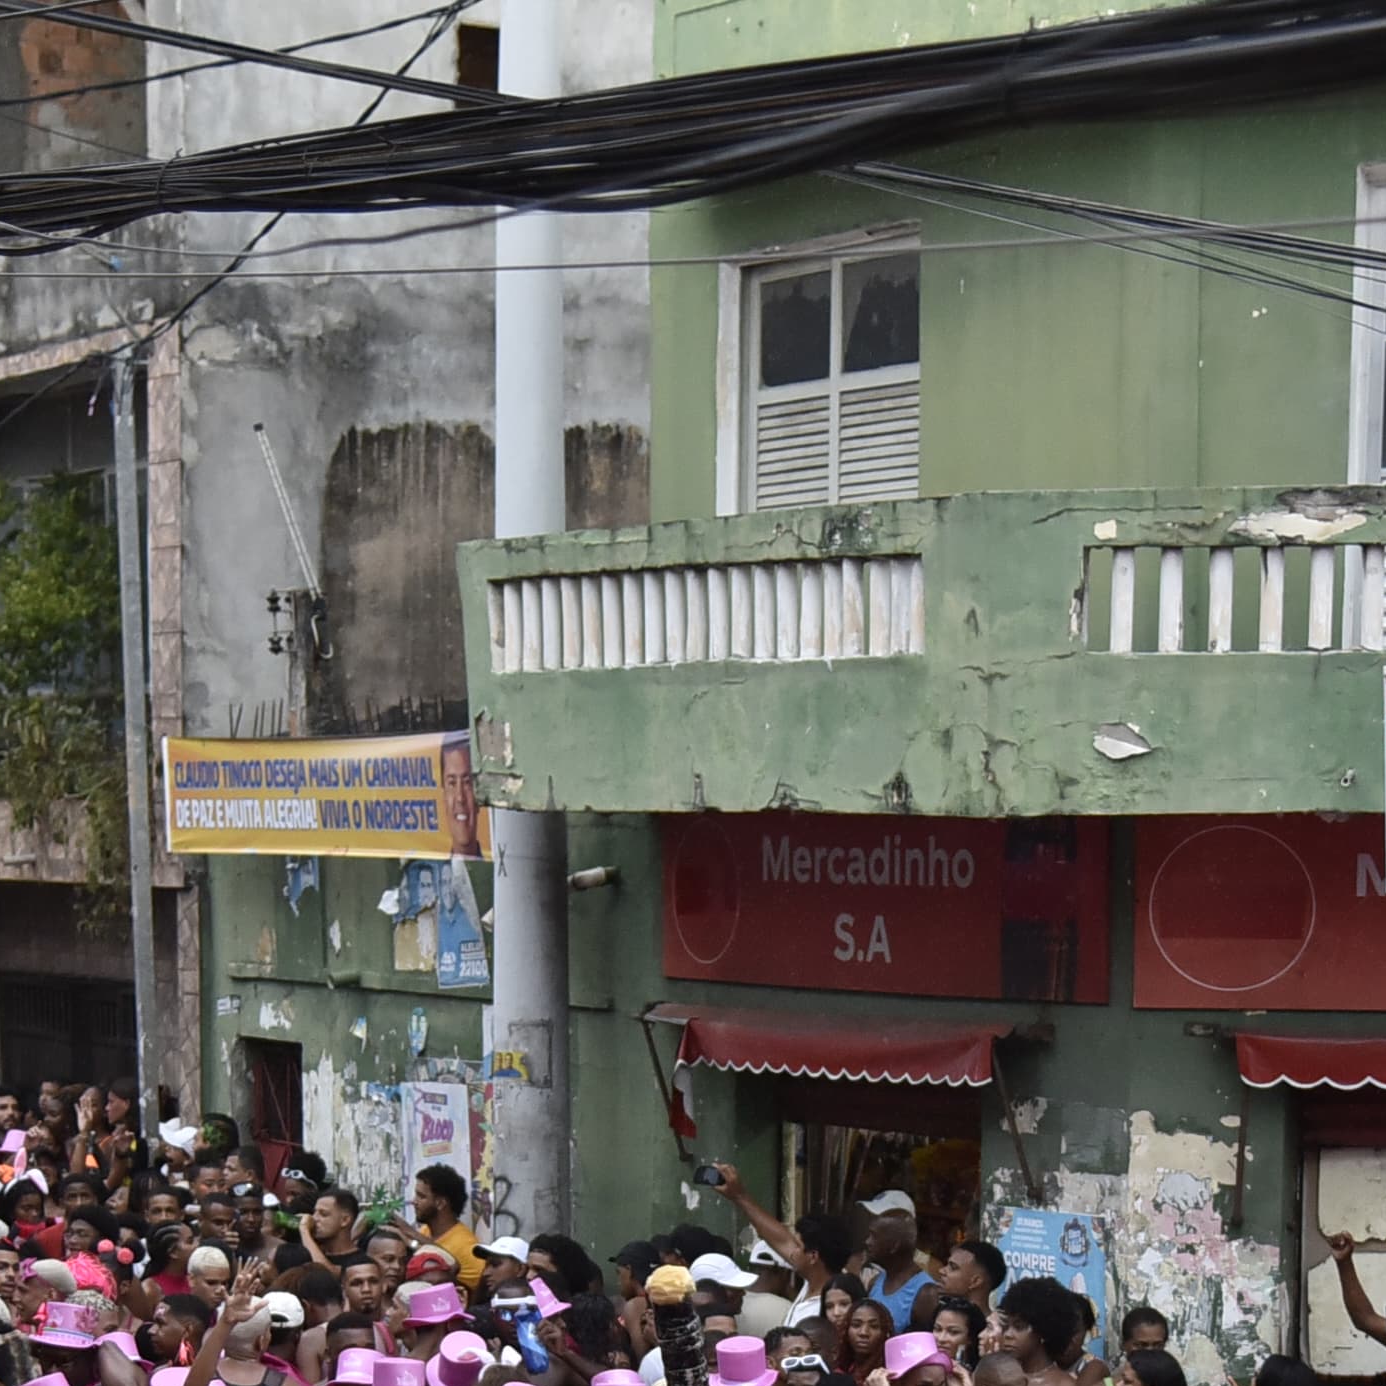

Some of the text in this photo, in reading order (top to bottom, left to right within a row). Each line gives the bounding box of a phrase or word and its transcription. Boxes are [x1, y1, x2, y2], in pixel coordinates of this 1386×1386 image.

[174, 756, 438, 795] CLAUDIO TINOCO DESEJA MAIS UM CARNAVAL
[176, 798, 439, 831] DE PAZ E MUITA ALEGRIA! VIVA O NORDESTE!
[762, 835, 975, 888] Mercadinho
[834, 913, 892, 964] S.A
[1003, 1250, 1056, 1272] COMPRE
